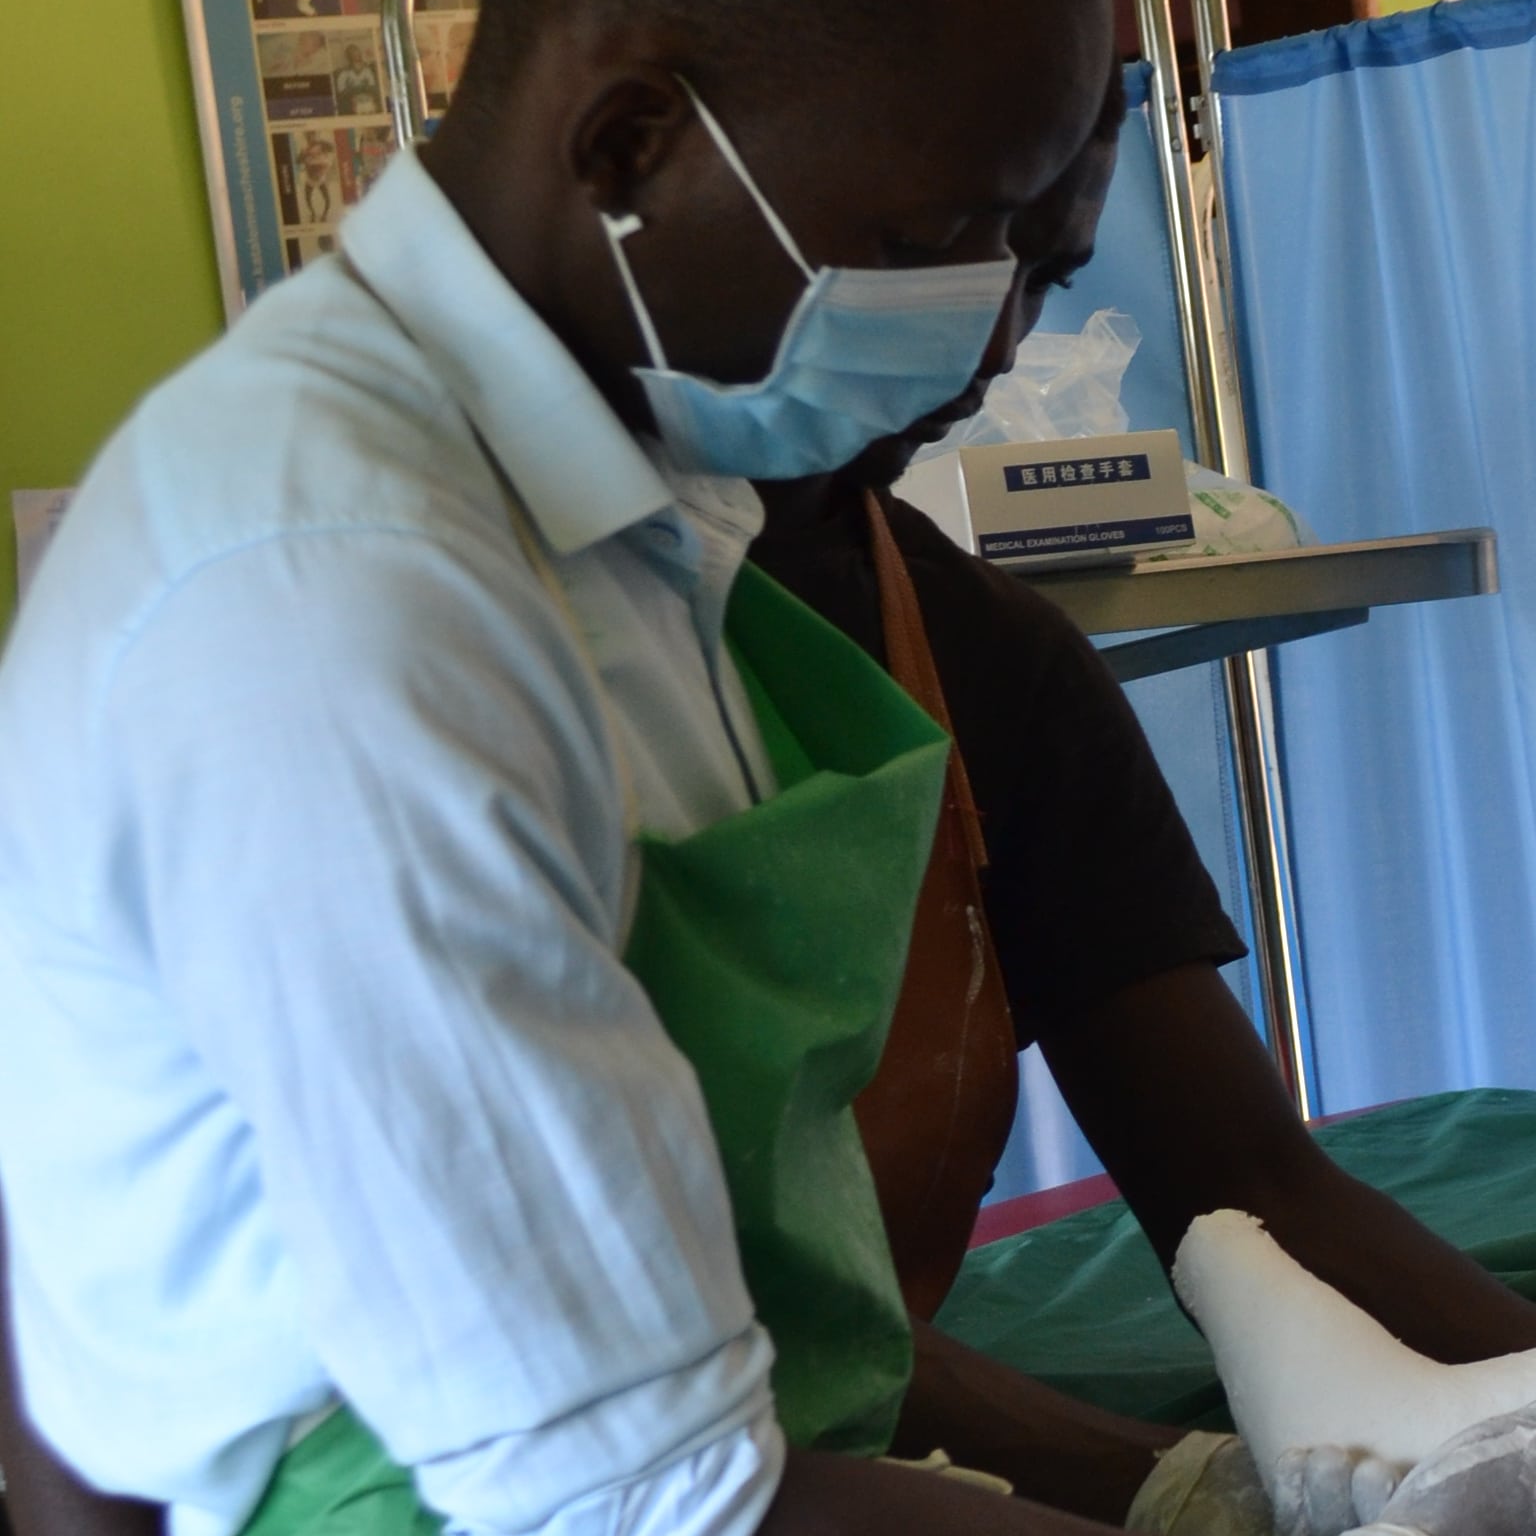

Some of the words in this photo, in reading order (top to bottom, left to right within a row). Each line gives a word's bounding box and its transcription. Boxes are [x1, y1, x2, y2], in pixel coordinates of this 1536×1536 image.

[1021, 460, 1134, 485] 医用检查手套
[1155, 523, 1188, 535] 100PCS
[985, 541, 1025, 552] MEDICAL
[1026, 534, 1088, 548] EXAMINATION
[1089, 530, 1125, 542] GLOVES
